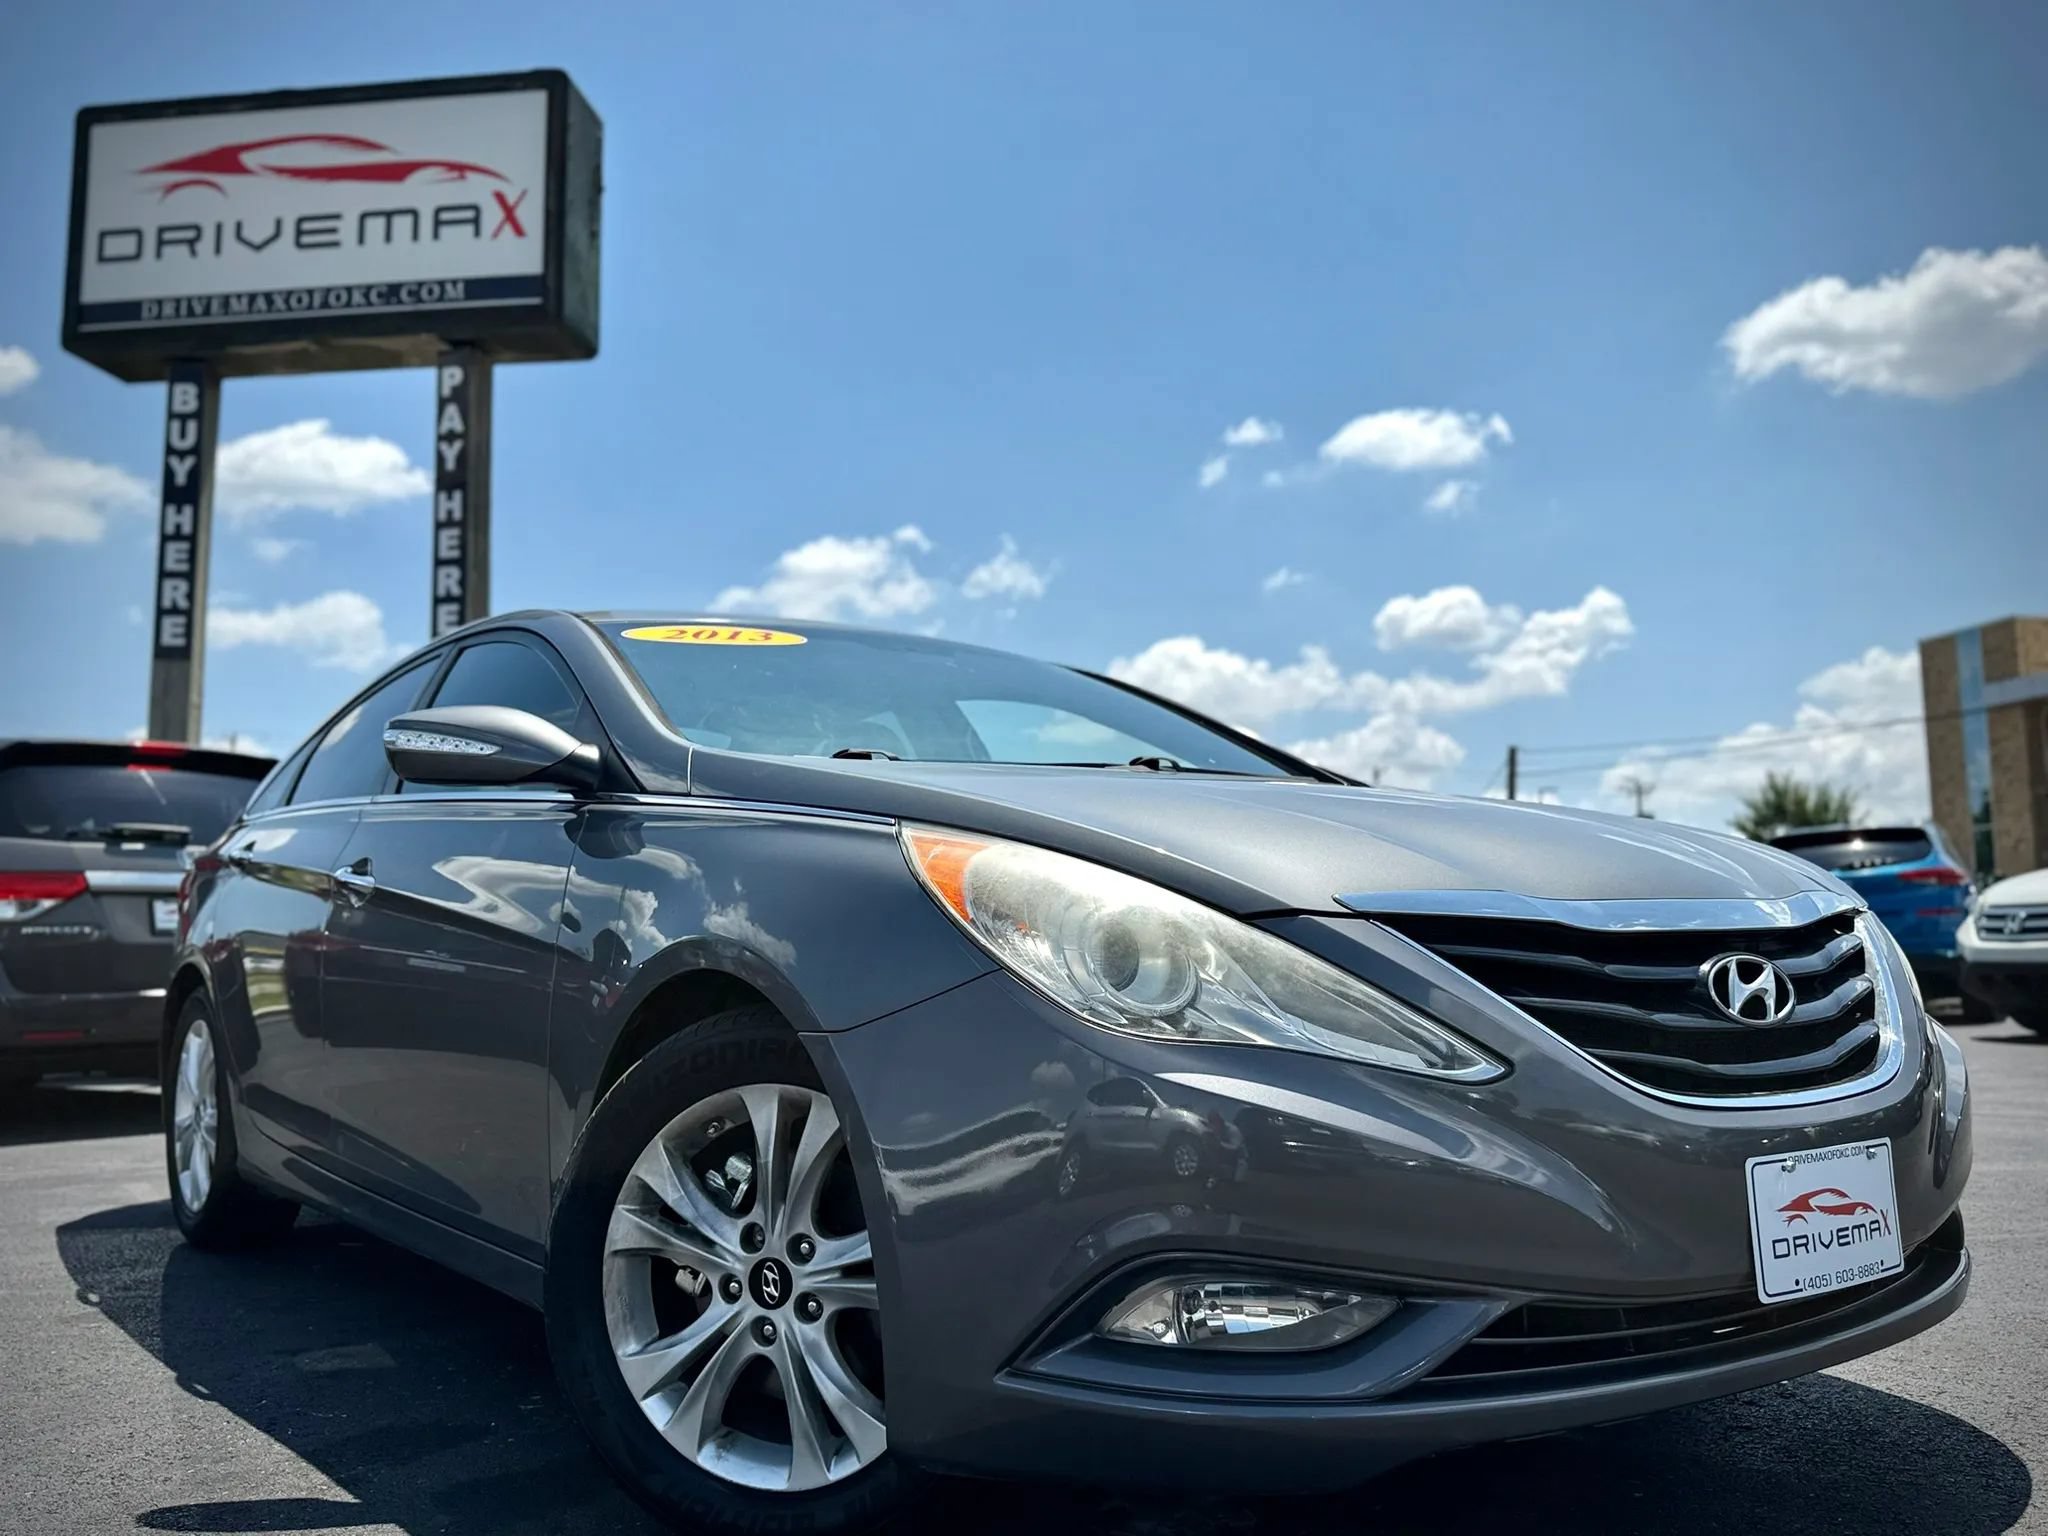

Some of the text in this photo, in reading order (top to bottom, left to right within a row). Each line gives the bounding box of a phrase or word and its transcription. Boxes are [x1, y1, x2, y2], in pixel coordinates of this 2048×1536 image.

[97, 187, 528, 264] DRIVEMAX
[141, 280, 467, 321] DRIVEMAXOFOKC.COM
[439, 364, 466, 472] PAY
[159, 382, 200, 647] BUY HERE
[663, 629, 773, 642] 2013
[1771, 1208, 1892, 1260] DRIVEMAX
[1802, 1261, 1880, 1292] (405) 603-8883
